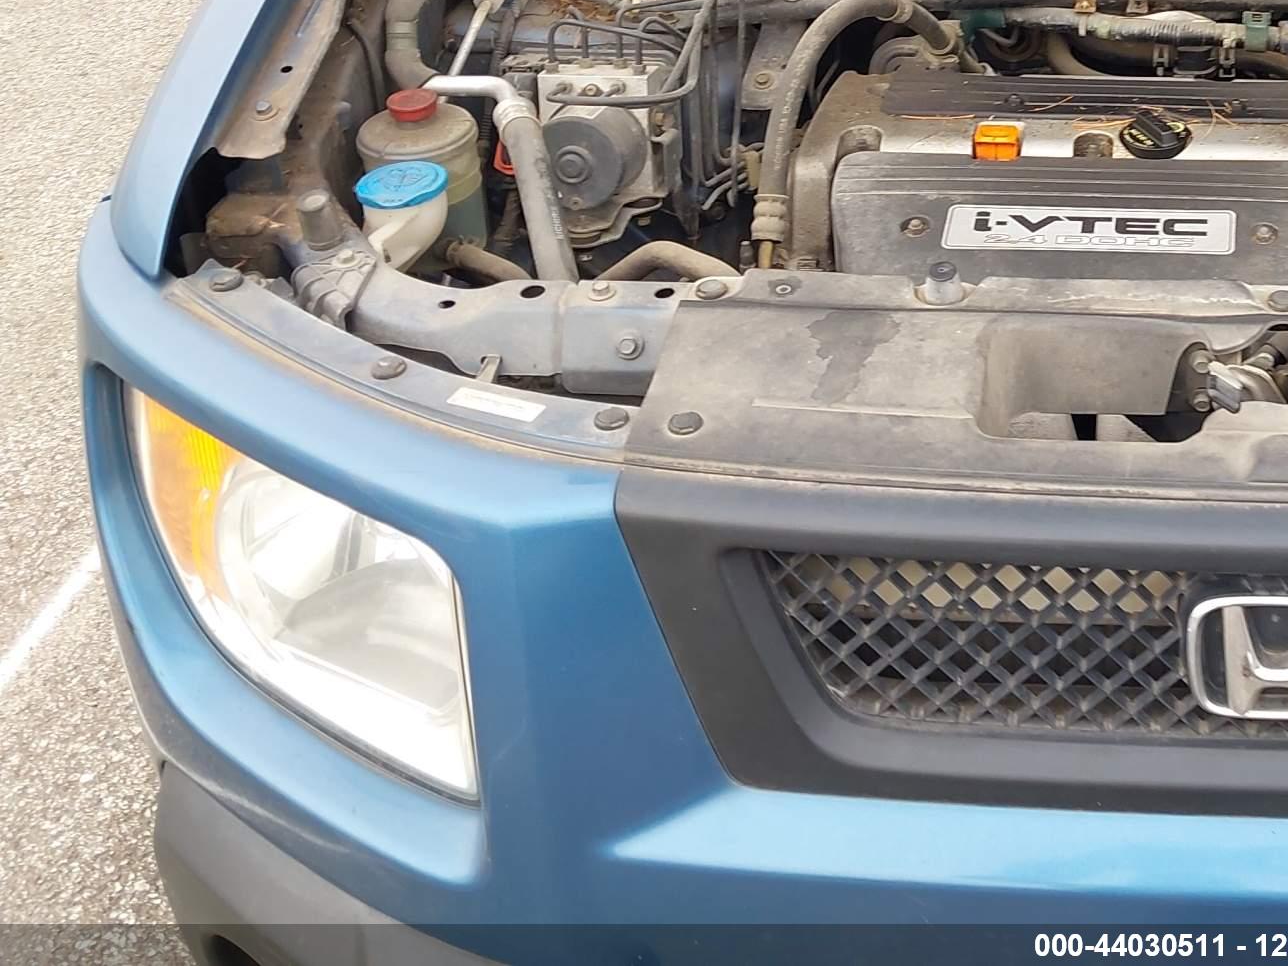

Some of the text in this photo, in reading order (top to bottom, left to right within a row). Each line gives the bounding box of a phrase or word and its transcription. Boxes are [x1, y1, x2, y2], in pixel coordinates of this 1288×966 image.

[973, 211, 1208, 236] i-VTEC
[984, 234, 1194, 248] 2.4 DOHC
